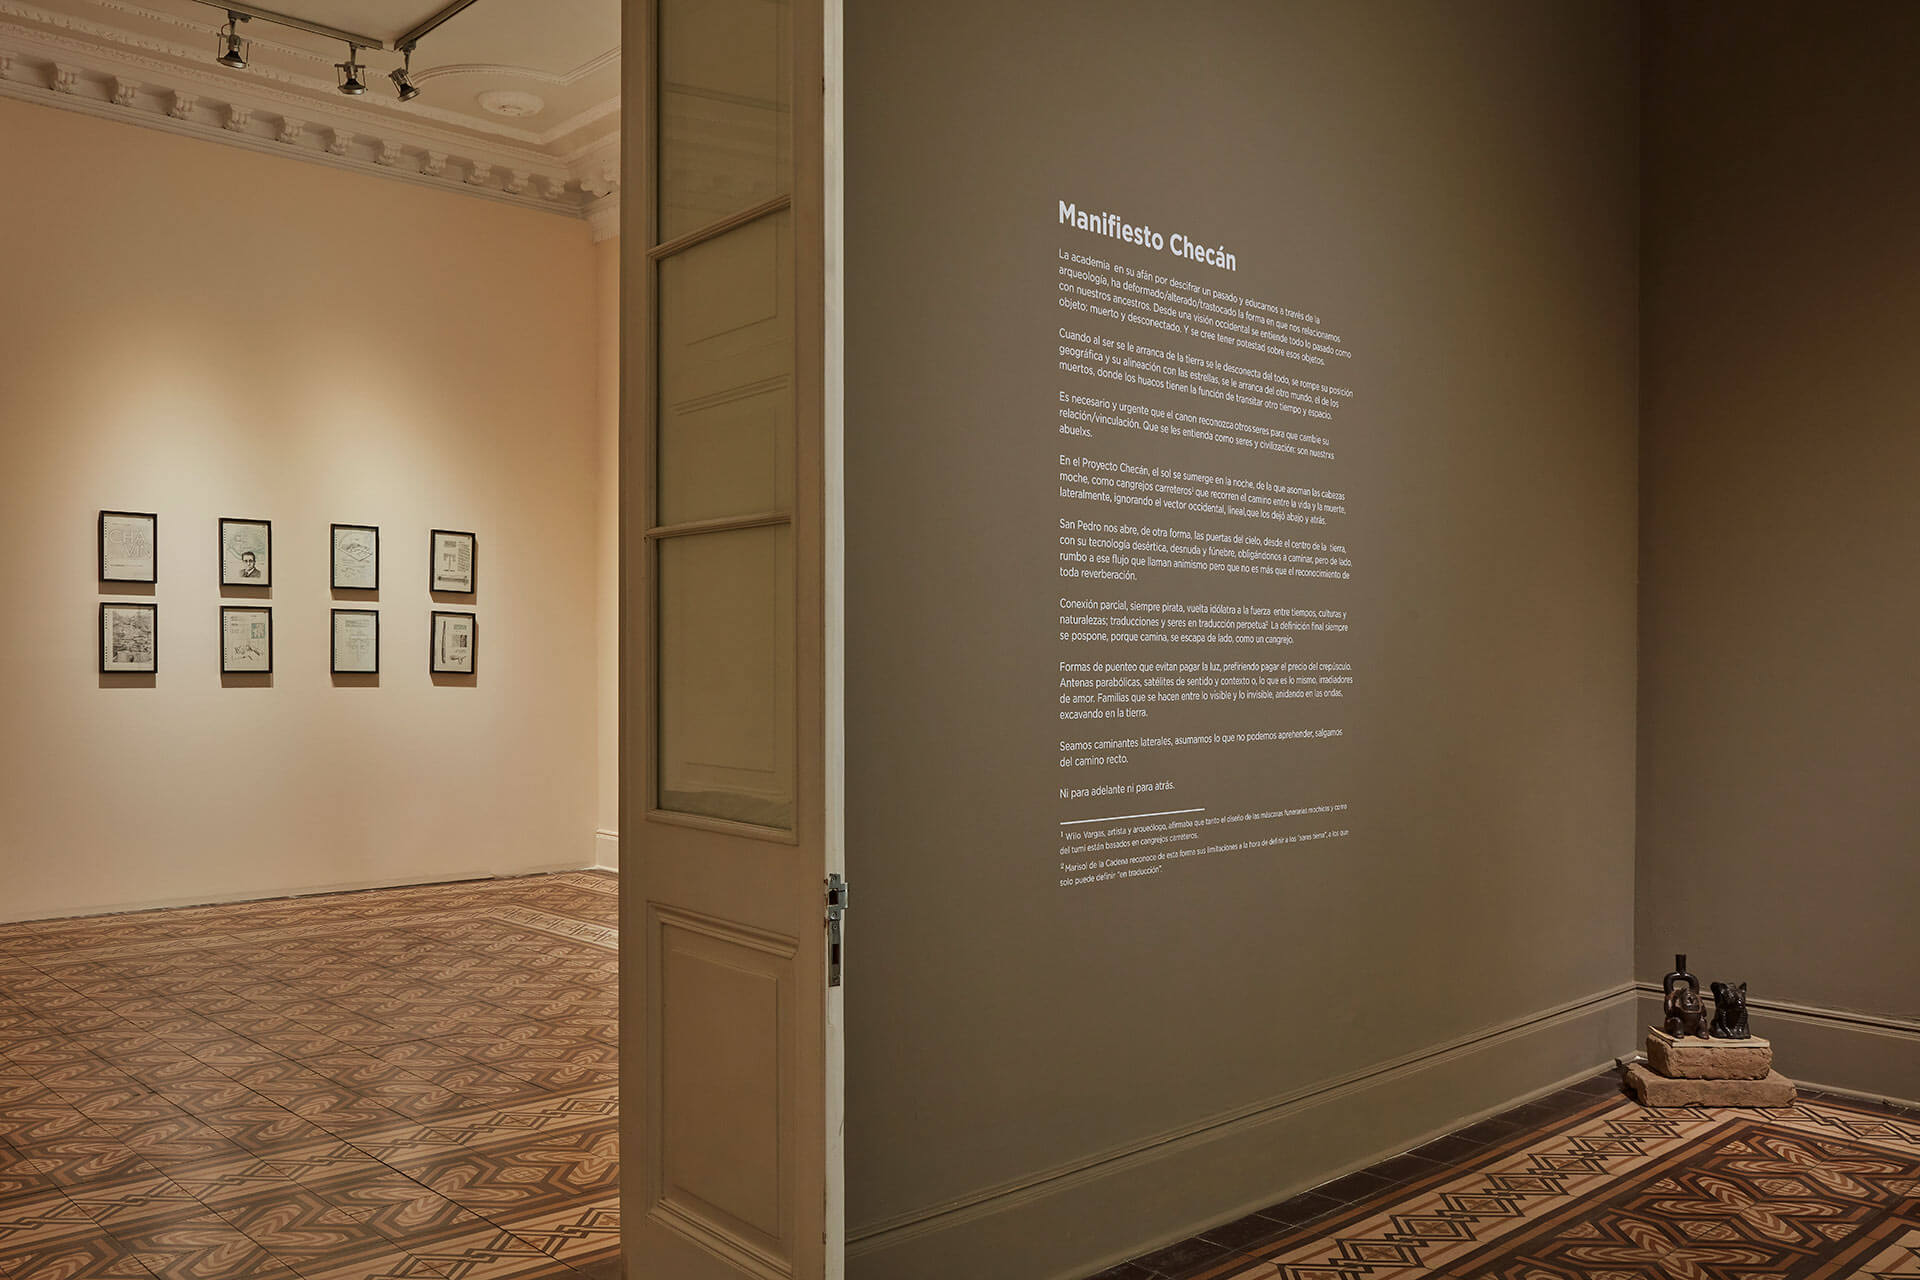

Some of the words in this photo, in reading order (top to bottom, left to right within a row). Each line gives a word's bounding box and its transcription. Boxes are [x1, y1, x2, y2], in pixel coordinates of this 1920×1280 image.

[1059, 200, 1164, 250] Manifiesto
[1170, 233, 1236, 271] Checán
[1058, 266, 1109, 287] arqueología,
[1111, 277, 1121, 289] ha
[1059, 248, 1069, 260] La
[1071, 253, 1110, 270] academia
[1114, 264, 1124, 274] en
[1125, 267, 1135, 277] su
[1136, 269, 1153, 281] afán
[1154, 275, 1168, 285] por
[1169, 277, 1201, 293] descifrar
[1058, 282, 1075, 293] con
[1076, 286, 1111, 302] nuestros
[1112, 295, 1152, 311] ancestros.
[1153, 302, 1177, 317] Desde
[1178, 311, 1192, 321] una
[1058, 297, 1088, 312] objeto:
[1090, 305, 1119, 319] muerto
[1127, 312, 1182, 333] desconectado.
[1059, 327, 1092, 344] Cuando
[1093, 335, 1101, 345] al
[1102, 338, 1115, 348] ser
[1116, 341, 1126, 351] se
[1127, 341, 1134, 353] le
[1135, 345, 1165, 359] arranca
[1059, 345, 1103, 362] geográfica
[1111, 356, 1121, 365] su
[1122, 357, 1161, 373] alineación
[1162, 366, 1177, 376] con
[1059, 361, 1095, 376] muertos,
[1097, 367, 1123, 381] donde
[1124, 372, 1136, 383] los
[1137, 374, 1165, 389] huacos
[1166, 380, 1189, 392] tienen
[1059, 391, 1070, 402] Es
[1071, 395, 1110, 409] necesario
[1119, 404, 1149, 415] urgente
[1150, 408, 1165, 418] que
[1142, 420, 1159, 432] Que
[1160, 425, 1169, 434] se
[1170, 425, 1181, 435] les
[1059, 454, 1071, 465] En
[1072, 457, 1080, 467] el
[1082, 457, 1118, 472] Proyecto
[1119, 462, 1151, 477] Checán,
[1059, 472, 1090, 485] moche,
[1091, 476, 1115, 487] como
[1116, 479, 1154, 492] cangrejos
[1059, 486, 1112, 503] lateralmente,
[1114, 492, 1154, 506] ignorando
[1154, 497, 1162, 507] el
[1163, 500, 1187, 510] vector
[1188, 502, 1226, 515] occidental,
[1059, 518, 1076, 529] San
[1077, 519, 1102, 532] Pedro
[1103, 524, 1118, 533] nos
[1119, 524, 1139, 536] abre,
[1140, 526, 1151, 536] de
[1152, 528, 1168, 537] otra
[1169, 527, 1193, 540] forma,
[1059, 536, 1076, 545] con
[1077, 537, 1087, 546] su
[1088, 537, 1131, 551] tecnología
[1132, 540, 1169, 553] desértica,
[1169, 544, 1201, 555] desnuda
[1059, 551, 1088, 562] rumbo
[1096, 555, 1110, 564] ese
[1112, 553, 1130, 566] flujo
[1130, 557, 1146, 567] que
[1059, 567, 1079, 577] toda
[1081, 568, 1137, 580] reverberación.
[1059, 598, 1099, 609] Conexión
[1100, 600, 1129, 611] parcial,
[1130, 601, 1161, 613] siempre
[1162, 602, 1185, 613] pirata,
[1186, 604, 1209, 614] vuelta
[1059, 614, 1108, 626] naturalezas;
[1110, 616, 1159, 627] traducciones
[1167, 619, 1186, 628] seres
[1059, 632, 1070, 641] se
[1071, 632, 1109, 642] pospone,
[1110, 633, 1138, 643] porque
[1139, 632, 1169, 643] camina,
[1170, 634, 1179, 642] se
[1059, 661, 1091, 672] Formas
[1092, 661, 1104, 672] de
[1105, 662, 1138, 673] puenteo
[1139, 663, 1154, 673] que
[1155, 662, 1178, 672] evitan
[1059, 678, 1094, 688] Antenas
[1095, 677, 1142, 689] parabólicas,
[1143, 677, 1175, 687] satélites
[1175, 677, 1186, 686] de
[1059, 693, 1071, 704] de
[1072, 695, 1096, 704] amor.
[1097, 692, 1130, 703] Familias
[1130, 694, 1146, 703] que
[1147, 694, 1156, 702] se
[1157, 692, 1180, 701] hacen
[1059, 708, 1104, 720] excavando
[1105, 710, 1116, 719] en
[1117, 708, 1124, 718] la
[1126, 708, 1148, 718] tierra.
[1059, 741, 1093, 751] Seamos
[1093, 738, 1139, 750] caminantes
[1140, 736, 1173, 747] laterales,
[1174, 735, 1212, 745] asumamos
[1059, 756, 1073, 768] del
[1074, 755, 1105, 767] camino
[1106, 754, 1129, 764] recto.
[1059, 788, 1069, 798] Ni
[1070, 788, 1089, 800] para
[1091, 784, 1126, 796] adelante
[1126, 783, 1134, 793] ni
[1136, 783, 1153, 794] para
[1154, 780, 1175, 791] atrás.
